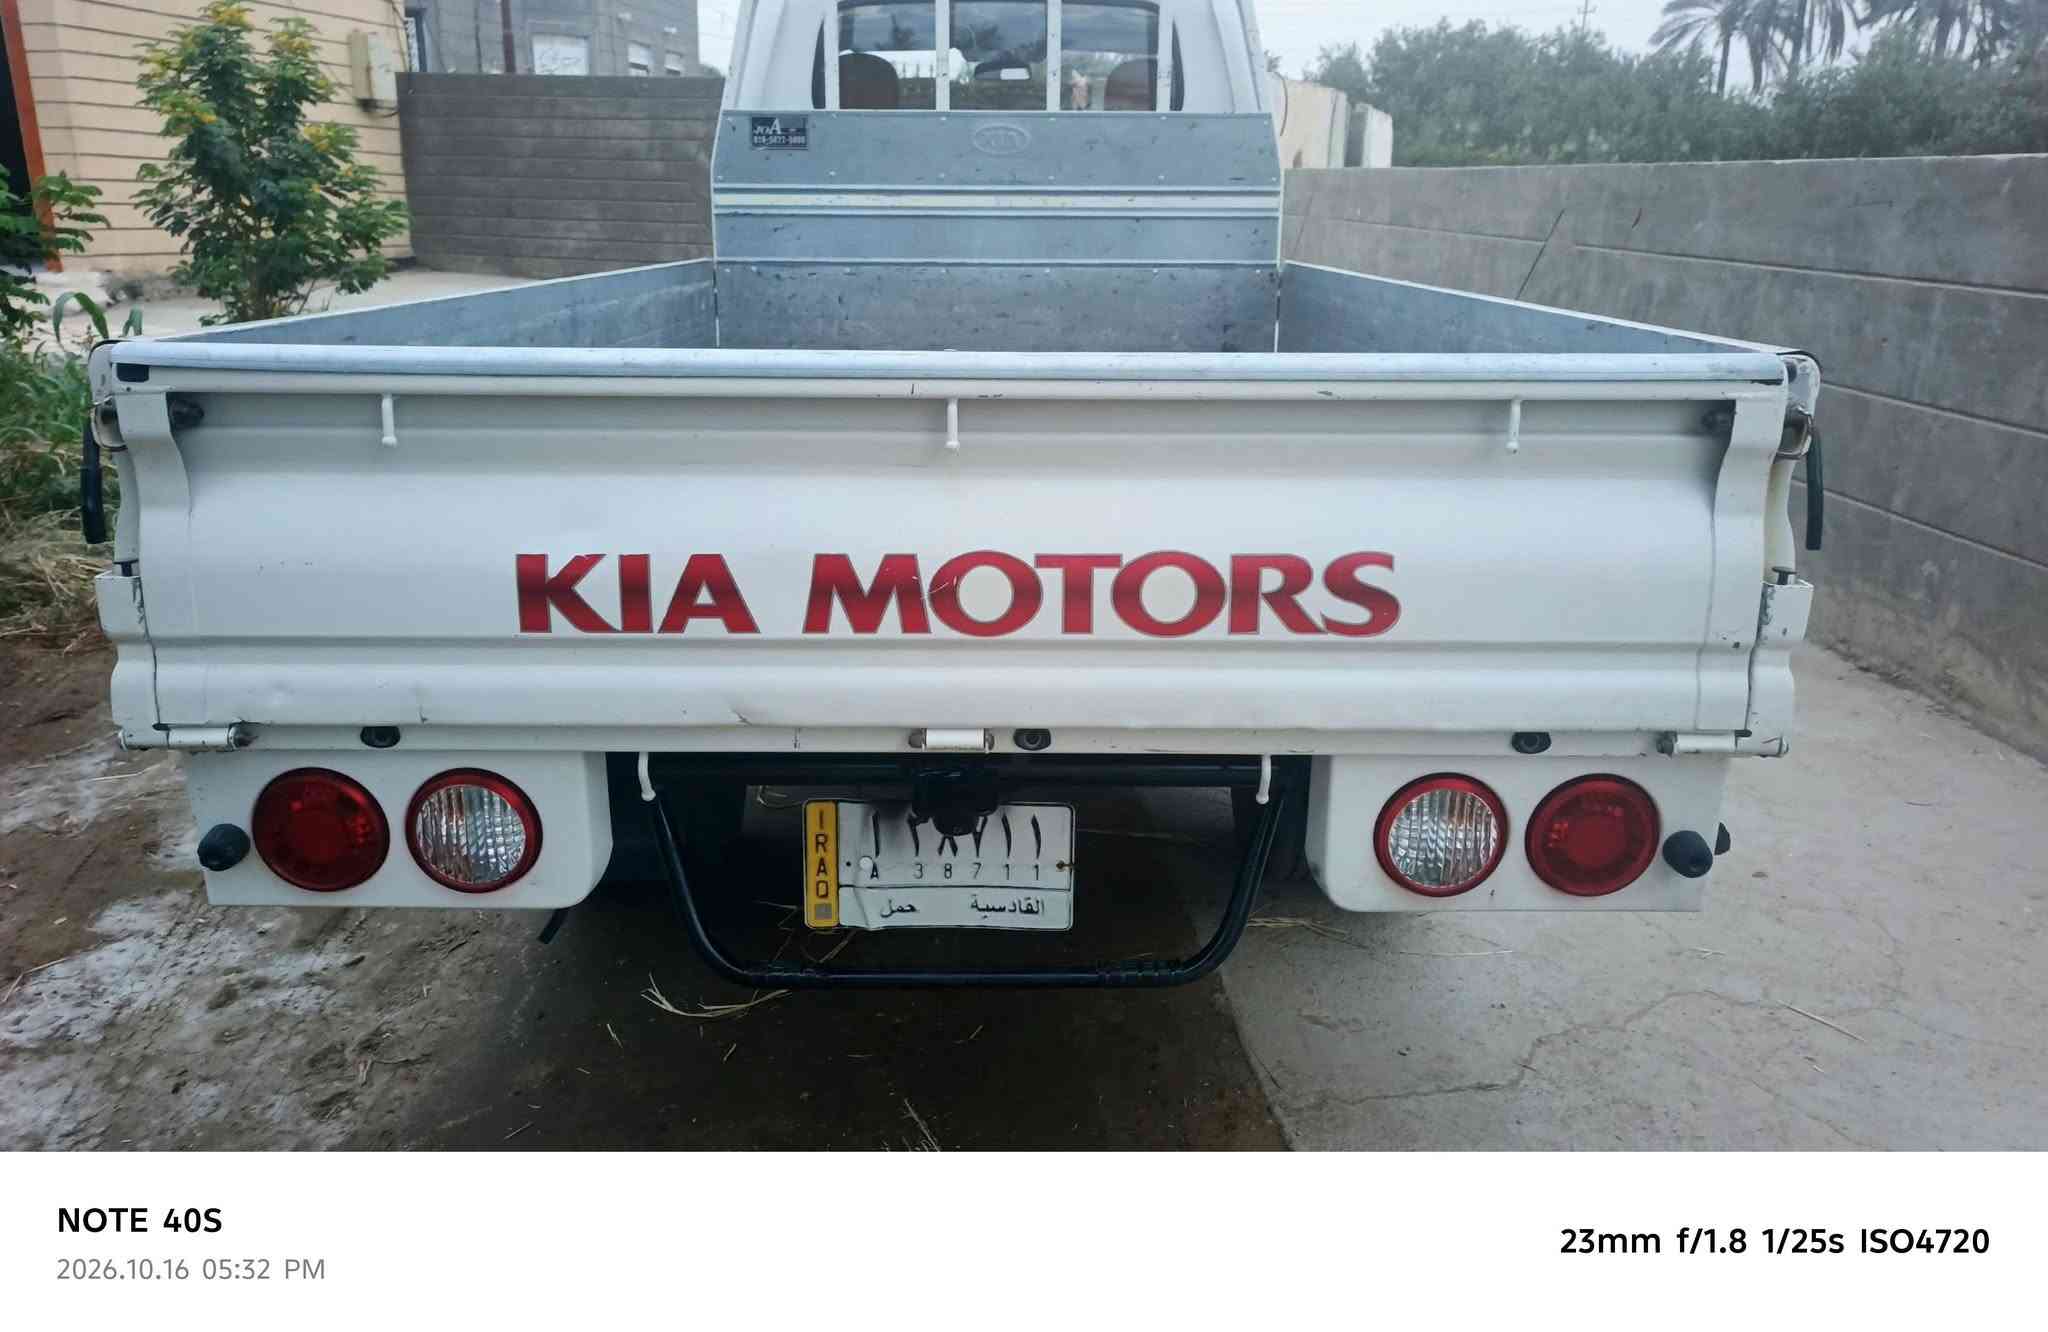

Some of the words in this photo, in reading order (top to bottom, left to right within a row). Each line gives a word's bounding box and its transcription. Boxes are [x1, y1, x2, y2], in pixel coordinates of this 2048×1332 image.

[517, 554, 757, 633] KIA
[803, 551, 1400, 638] MOTORS
[815, 810, 829, 899] IRAQ
[880, 899, 920, 919] حمل
[970, 893, 1046, 919] القادسية
